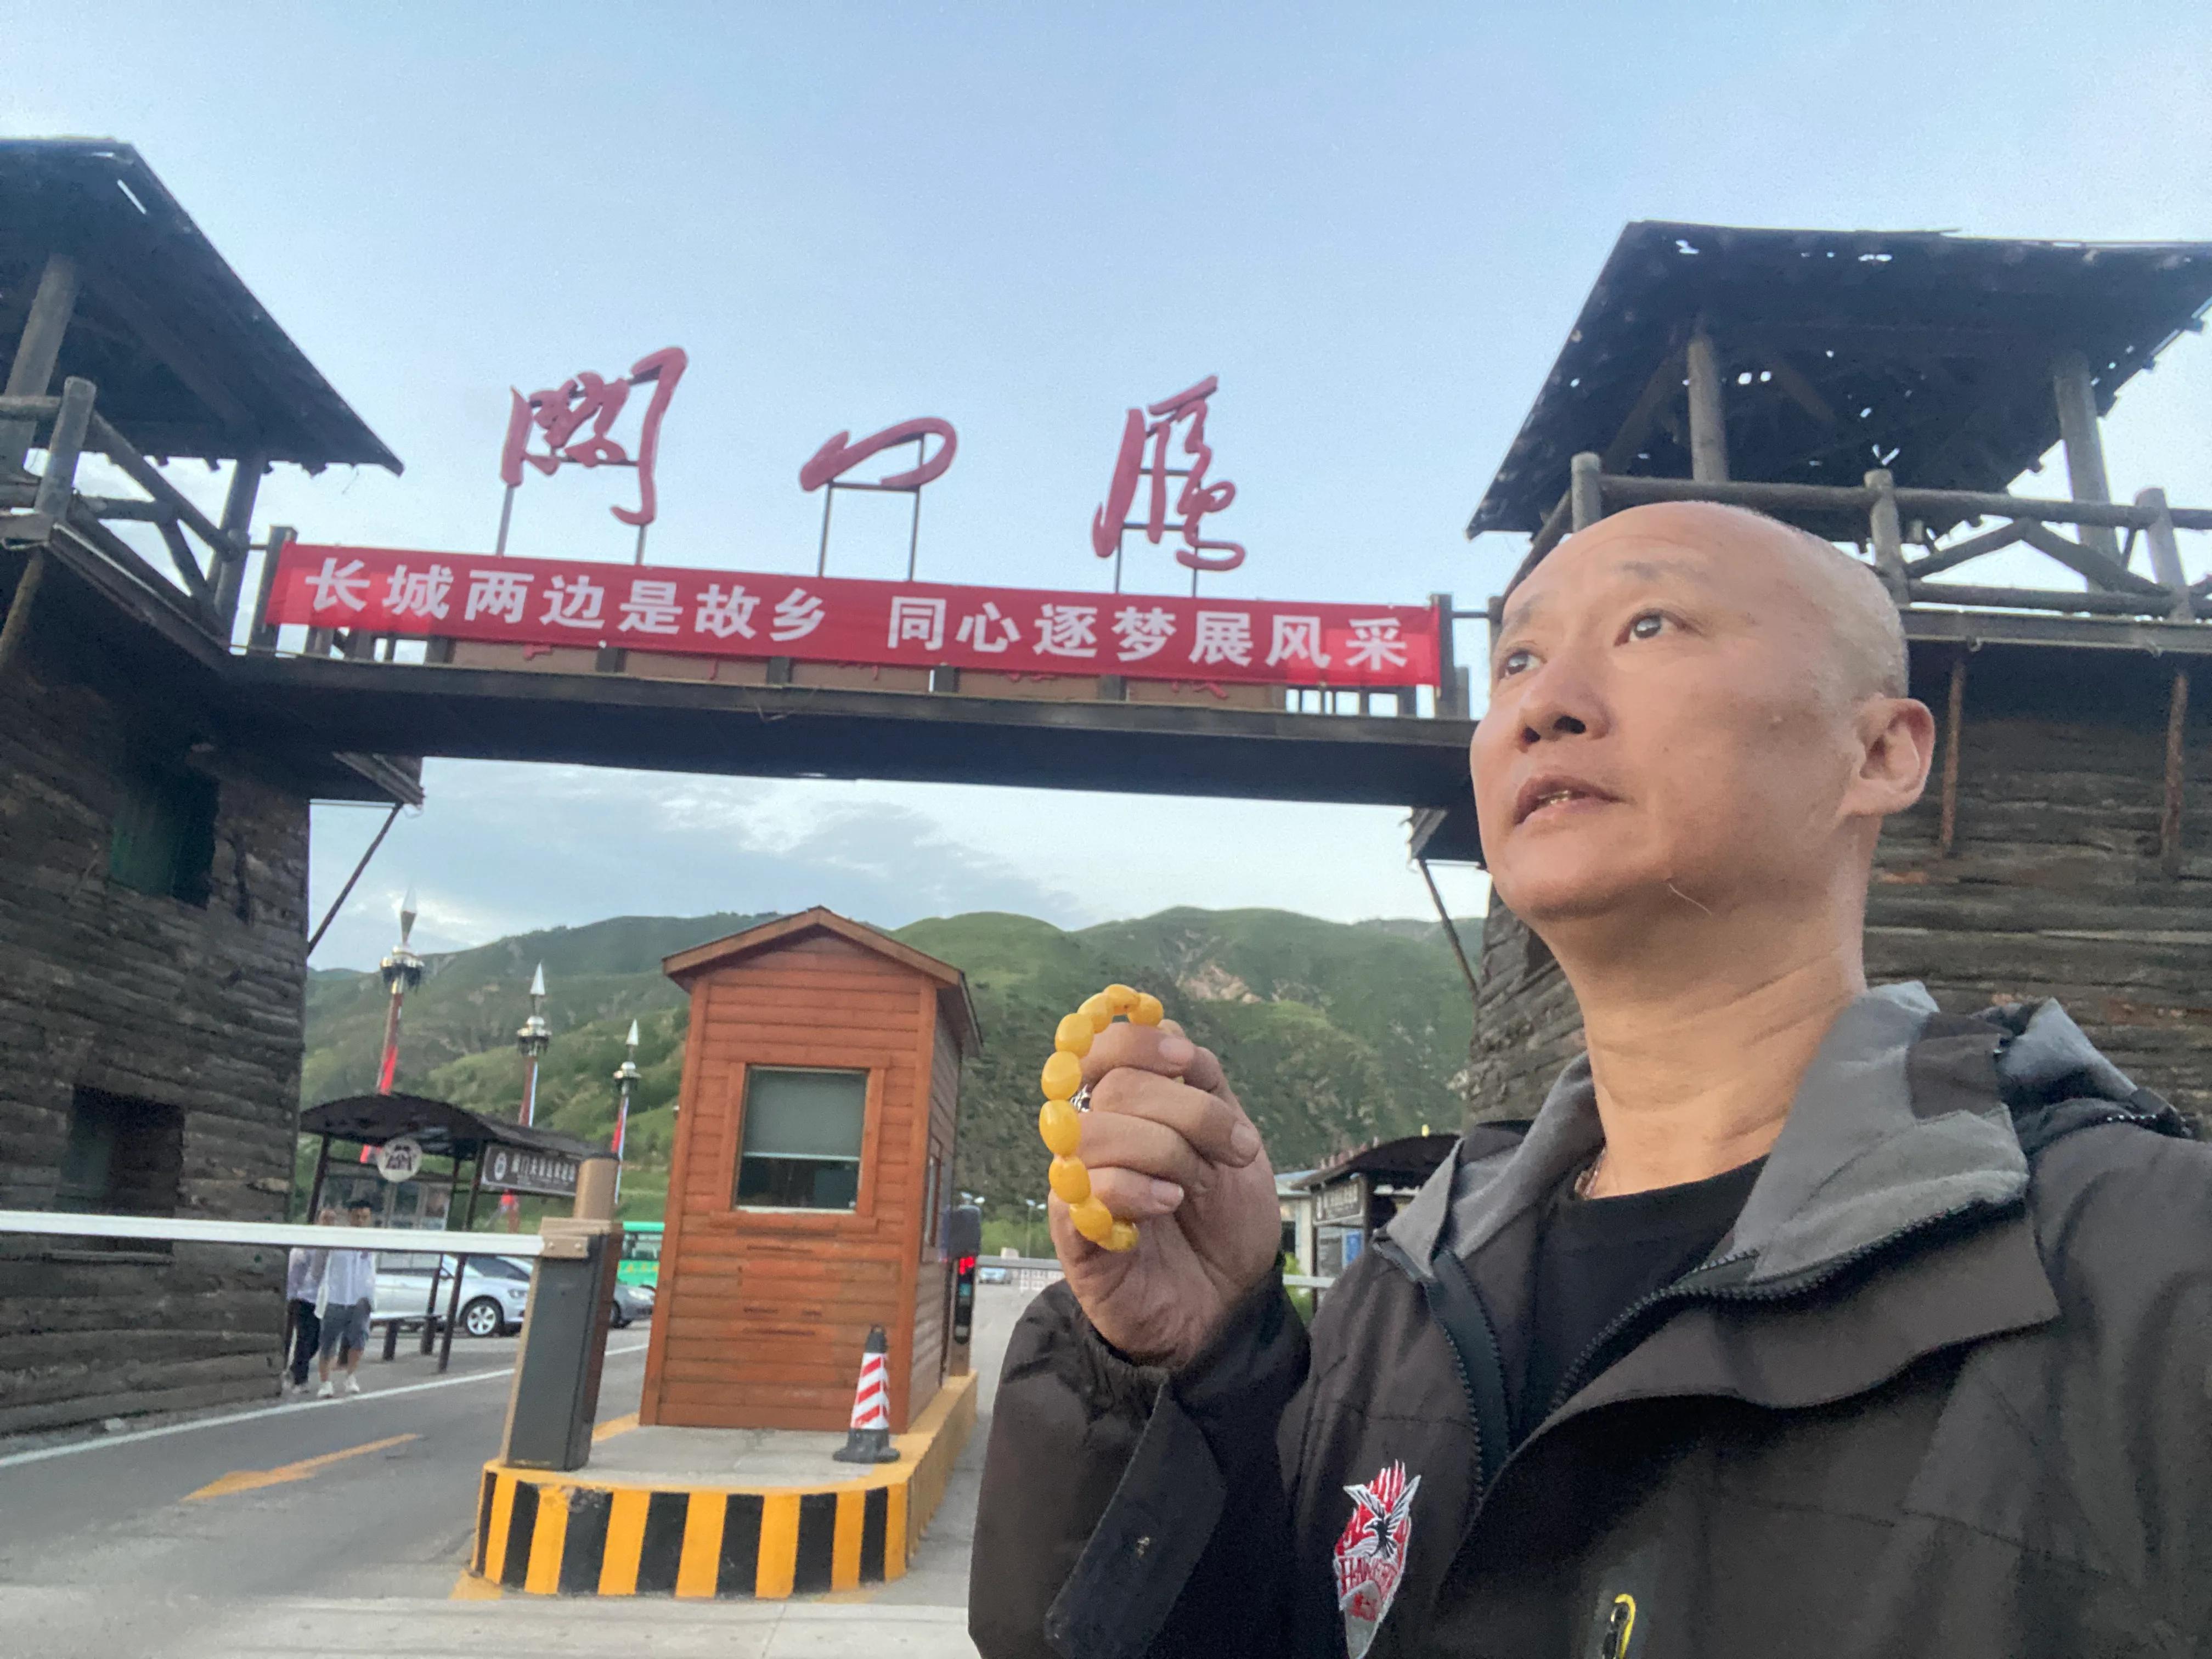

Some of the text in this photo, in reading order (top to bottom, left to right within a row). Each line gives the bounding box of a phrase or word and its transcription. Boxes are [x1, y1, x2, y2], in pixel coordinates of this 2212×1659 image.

[305, 557, 826, 642] 长城两边是故乡
[887, 595, 1408, 672] 同心逐梦展风采
